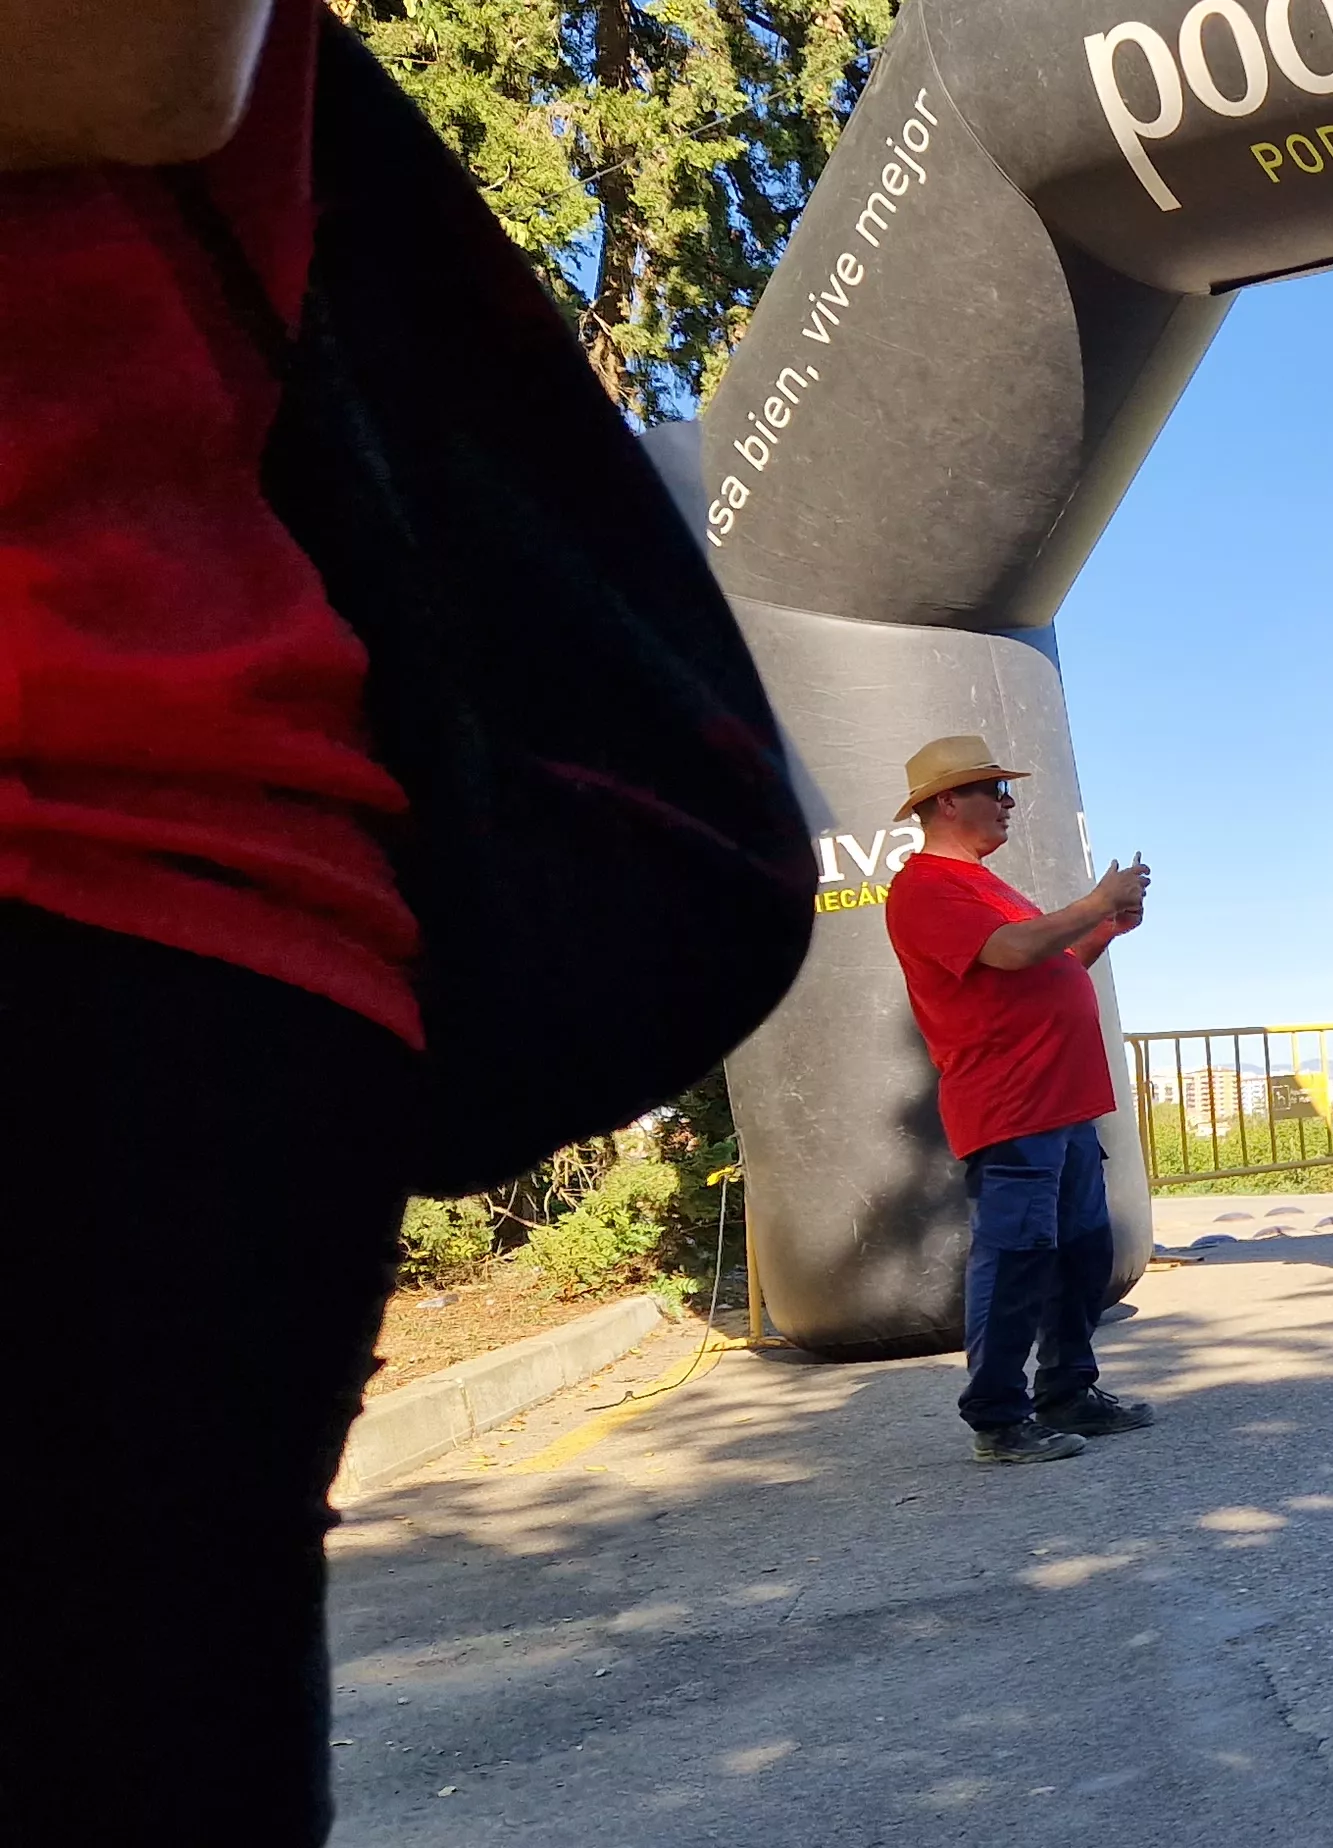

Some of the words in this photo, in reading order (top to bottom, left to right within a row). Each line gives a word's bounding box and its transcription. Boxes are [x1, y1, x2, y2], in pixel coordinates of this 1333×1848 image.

[733, 364, 820, 472] bien,
[802, 252, 865, 344] vive
[855, 88, 939, 248] mejor
